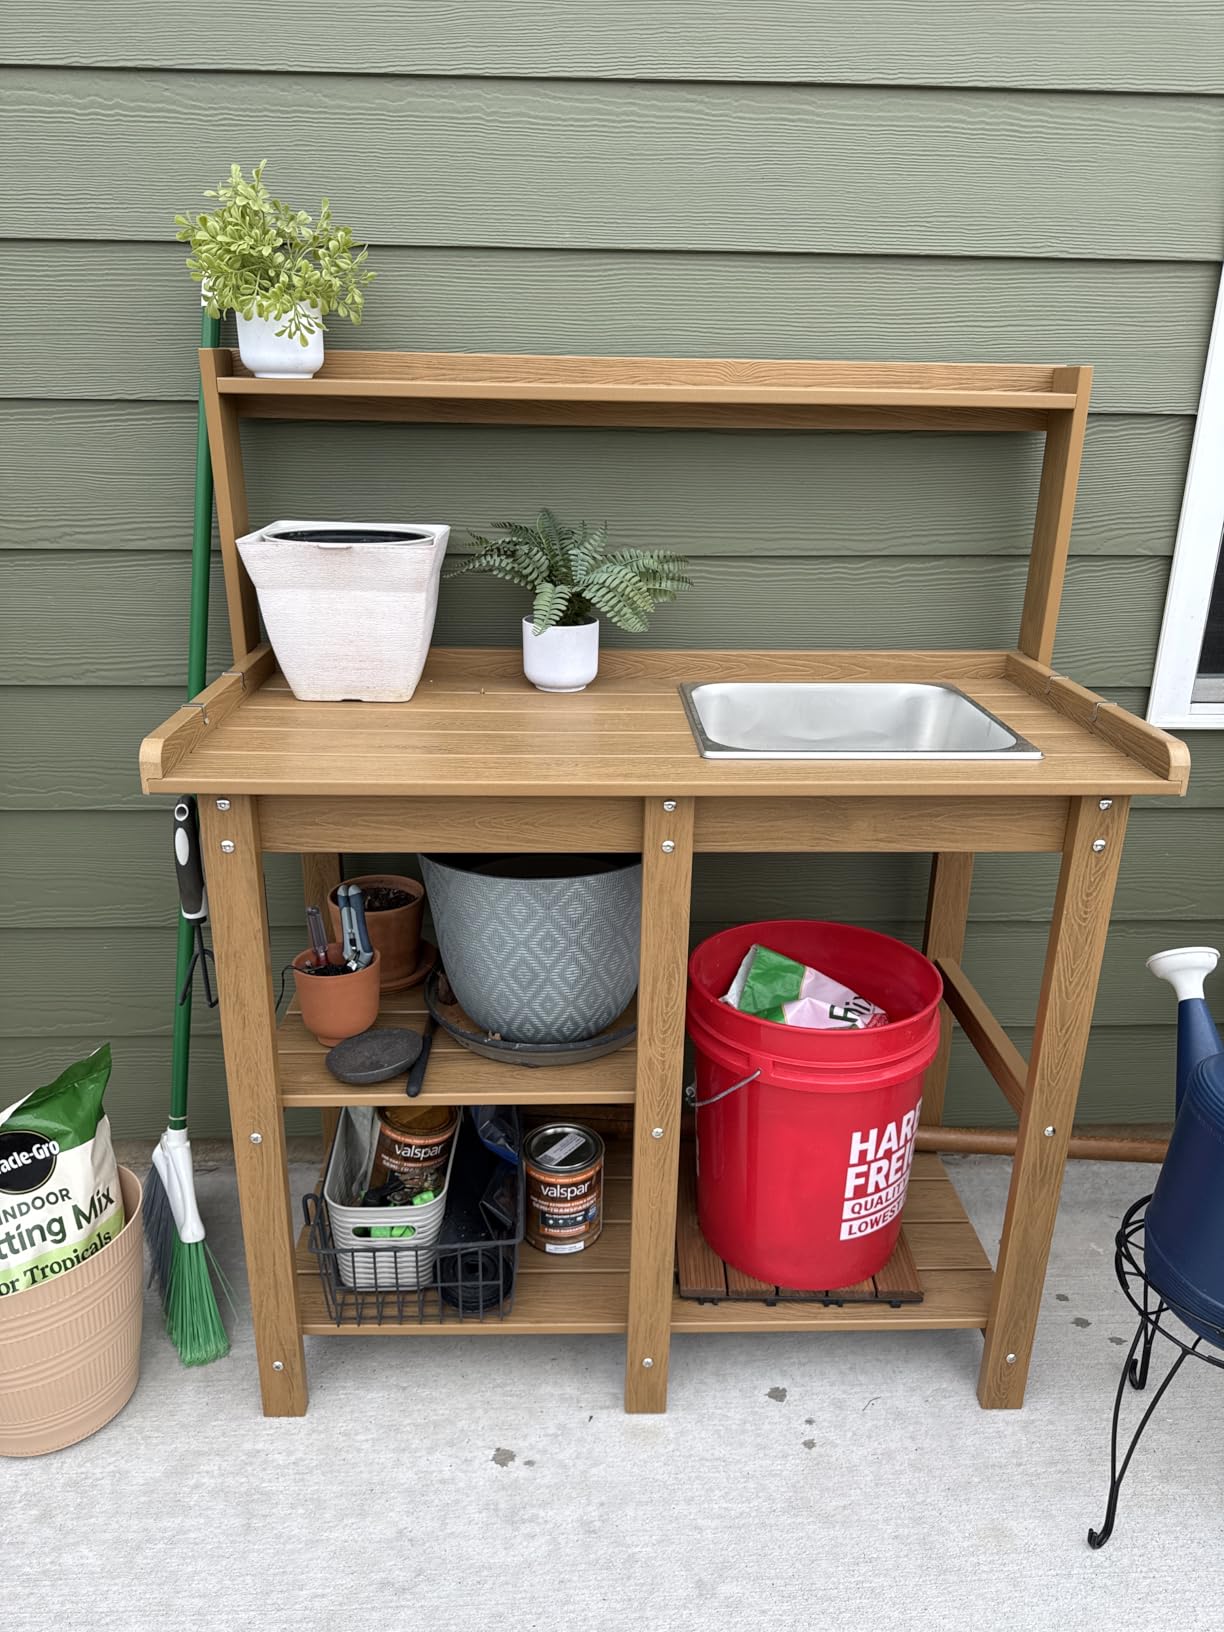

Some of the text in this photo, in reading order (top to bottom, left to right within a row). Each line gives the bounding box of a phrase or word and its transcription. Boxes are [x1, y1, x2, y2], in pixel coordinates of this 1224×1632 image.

[395, 1144, 444, 1161] valspar
[541, 1182, 591, 1200] valspar
[72, 1186, 115, 1231] Mix
[847, 1203, 902, 1237] LOWEST
[23, 1230, 112, 1286] Tropicals
